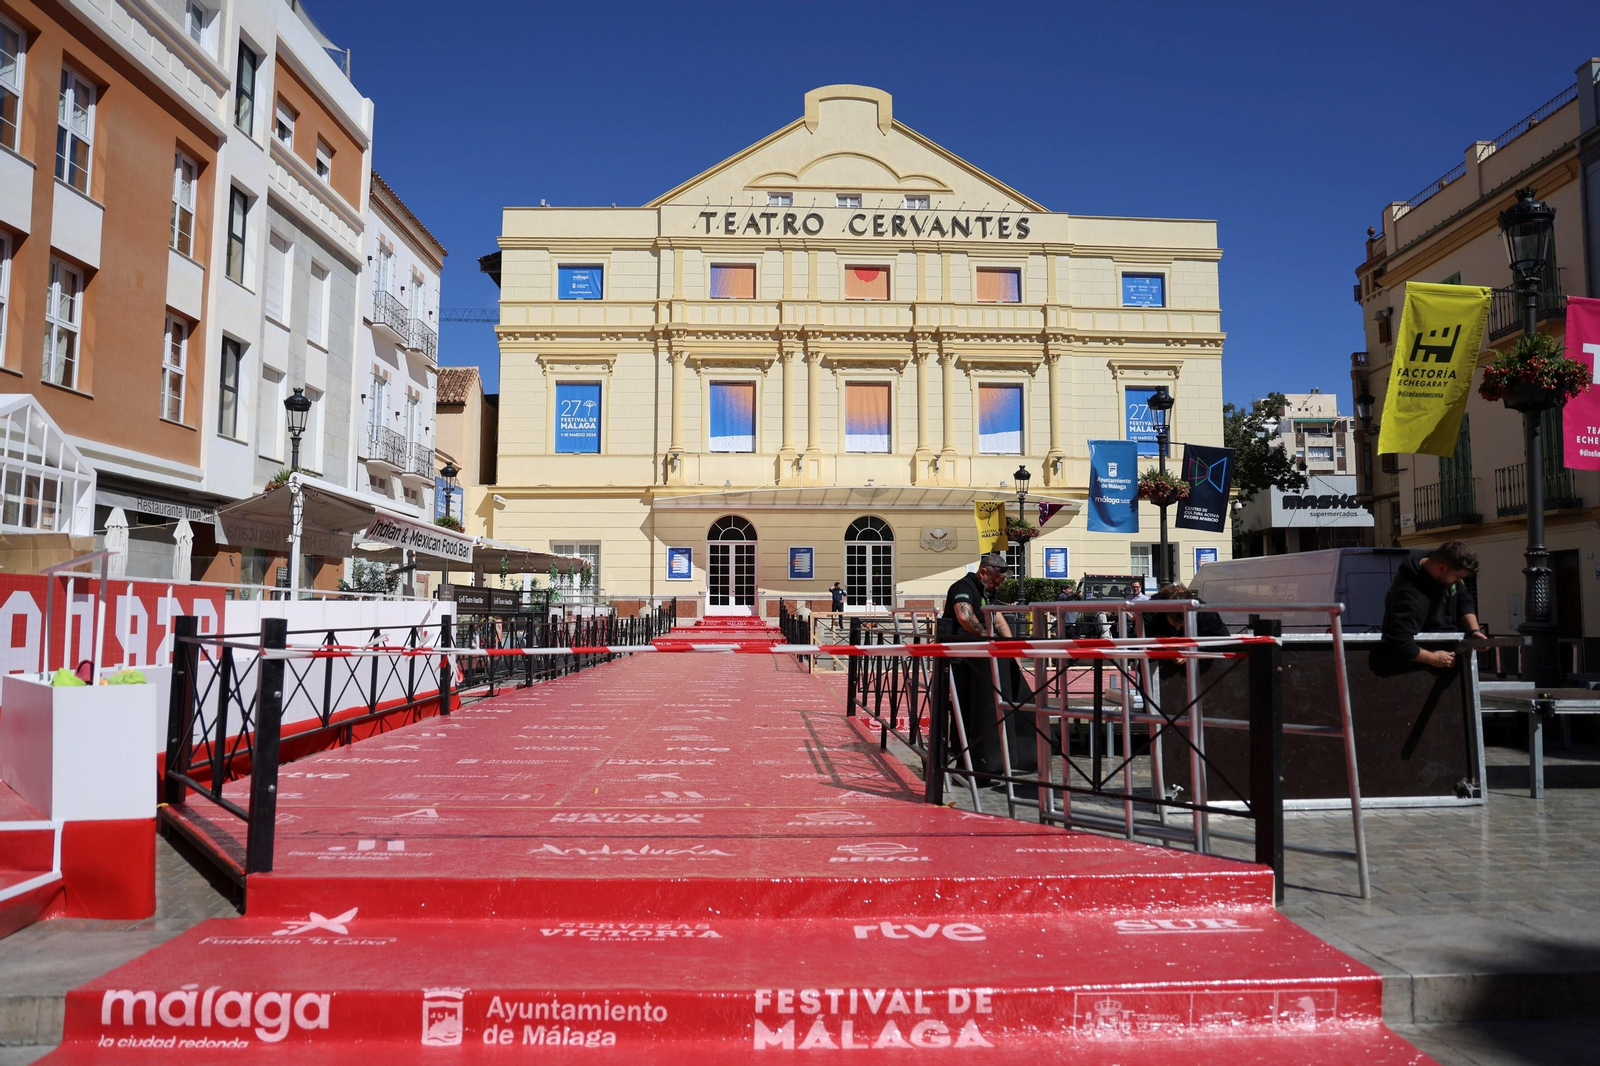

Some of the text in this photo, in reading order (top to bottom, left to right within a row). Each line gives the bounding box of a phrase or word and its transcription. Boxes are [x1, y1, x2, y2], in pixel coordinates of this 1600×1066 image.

[698, 211, 1031, 240] TEATRO CERVANTES
[1397, 366, 1457, 379] FACTORÍA
[1398, 379, 1449, 388] ECHEGARAY
[561, 399, 582, 417] 27
[1129, 403, 1148, 421] 27
[1096, 476, 1132, 485] Ayuntamiento
[1094, 495, 1120, 506] málaga
[136, 496, 183, 518] Restaurante
[184, 505, 202, 522] Vino
[1309, 510, 1358, 518] supermercados
[1199, 515, 1219, 523] APARICIO
[369, 519, 469, 558] Indian & Mexican Food Bar
[525, 843, 737, 857] Andalucía
[558, 922, 711, 930] CERVEZAS
[853, 921, 987, 942] rtve
[1113, 916, 1246, 931] SUR
[539, 928, 724, 939] VICTORIA
[753, 986, 994, 1015] FESTIVAL DE
[100, 983, 332, 1043] málaga
[485, 995, 668, 1023] Ayuntamiento
[482, 1024, 617, 1048] de Málaga
[752, 1013, 996, 1051] MÁLAGA
[97, 1034, 250, 1049] la ciudad redonda
